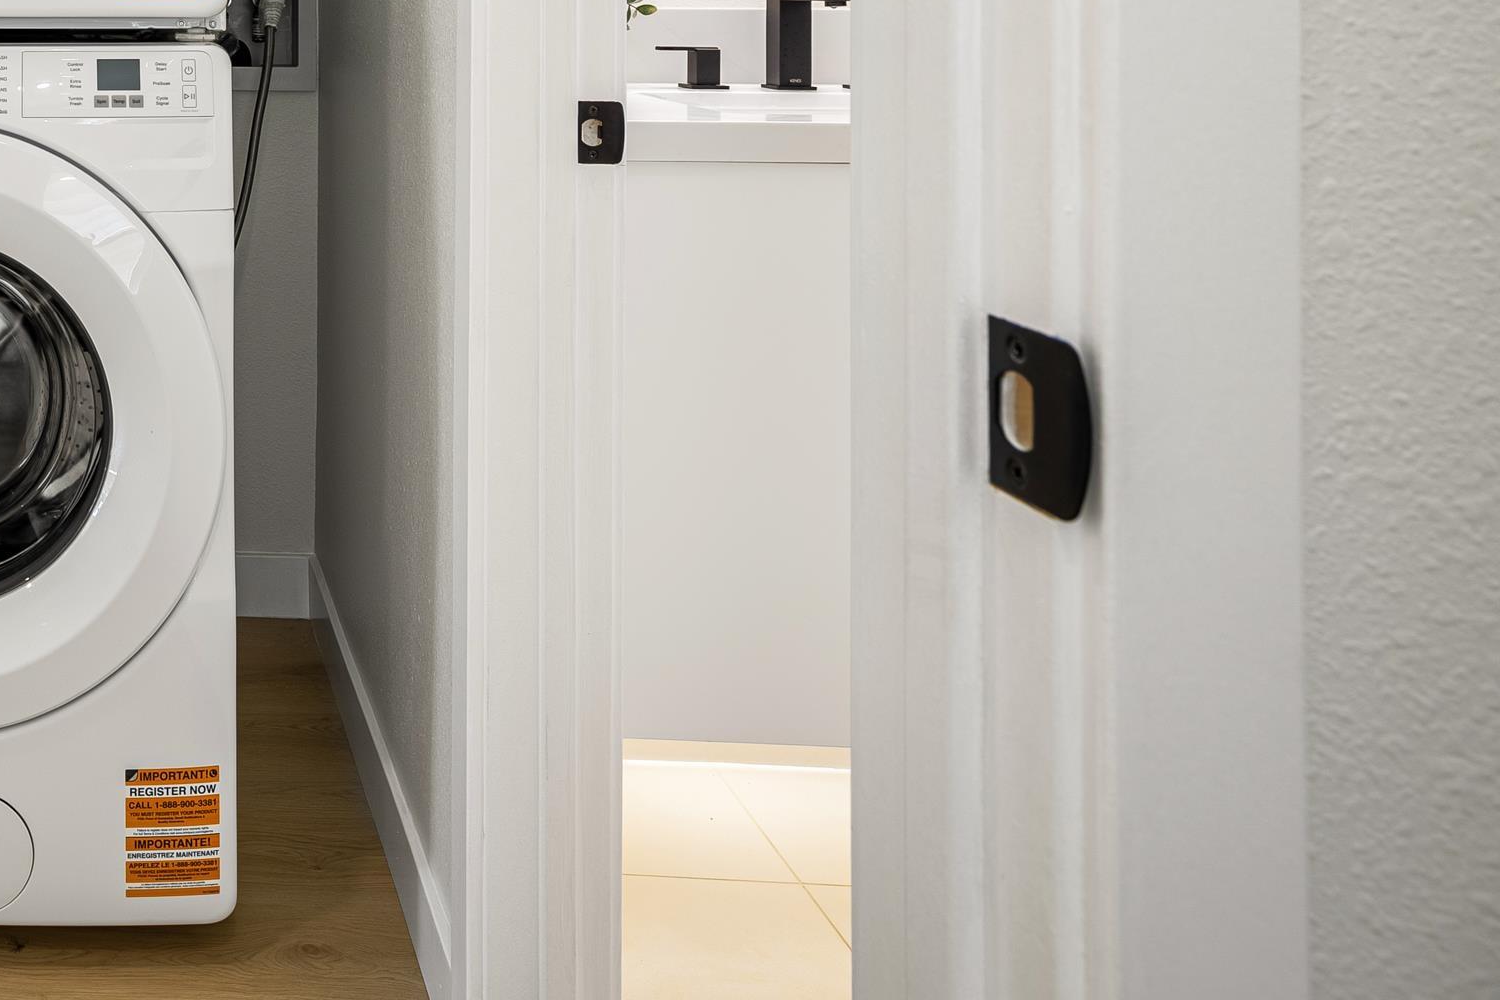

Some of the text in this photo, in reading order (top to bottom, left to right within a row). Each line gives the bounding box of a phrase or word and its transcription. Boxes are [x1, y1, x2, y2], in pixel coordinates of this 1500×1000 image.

[139, 769, 209, 782] IMPORTANT!
[129, 784, 216, 796] REGISTER NOW
[129, 798, 217, 809] CALL 1-888-900-3381
[134, 837, 211, 849] IMPORTANTE!
[176, 849, 219, 858] MAINTENANT
